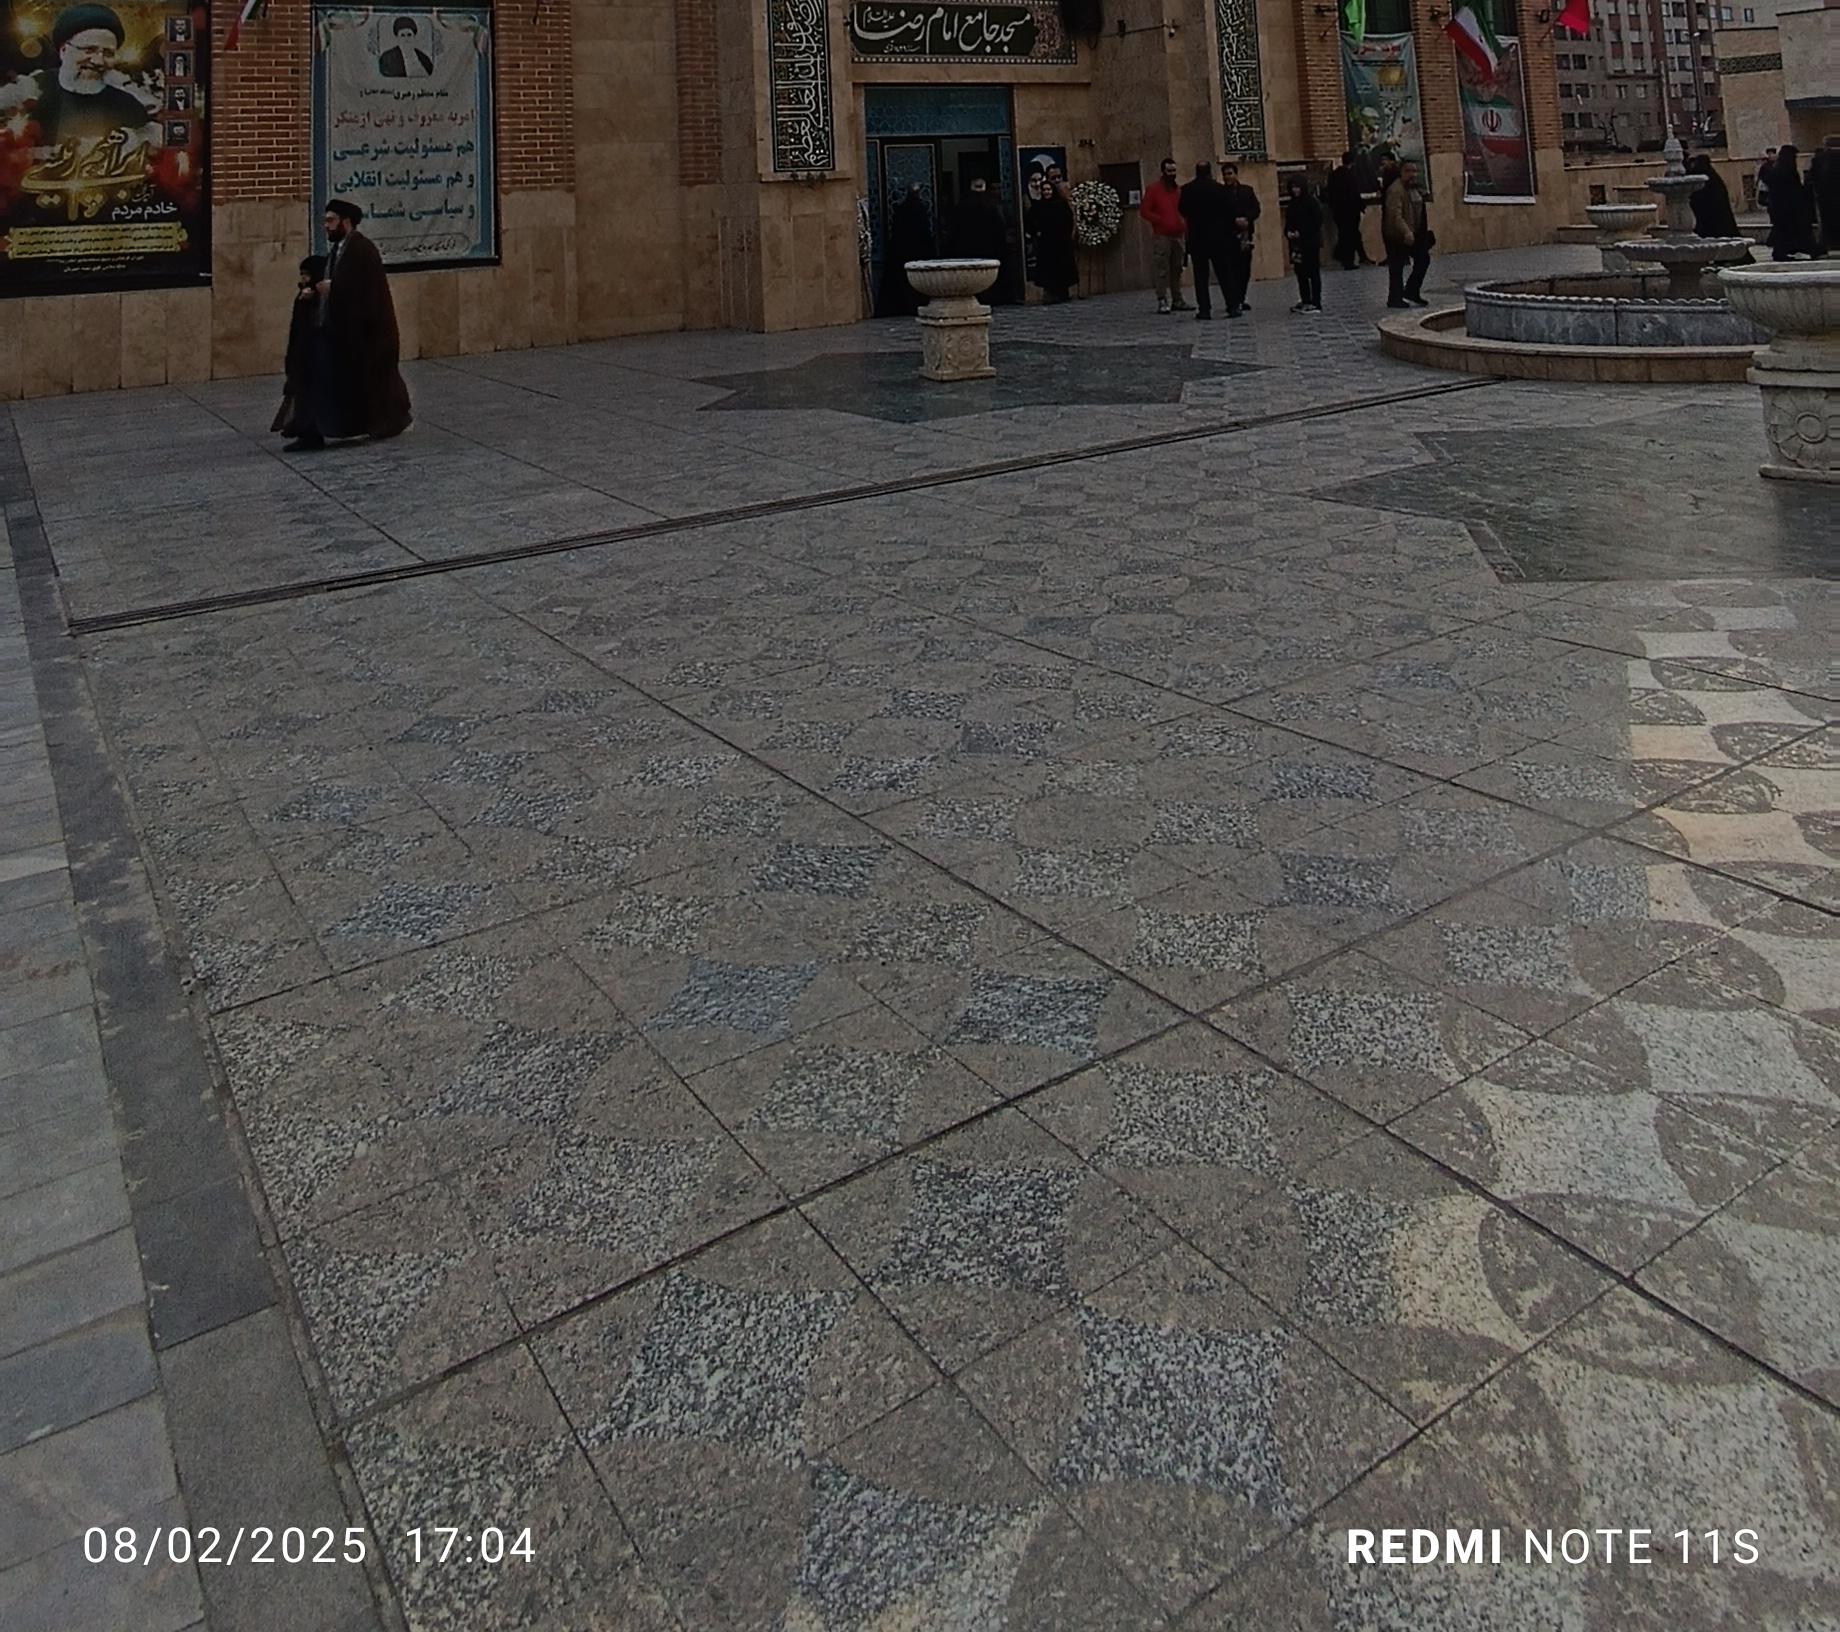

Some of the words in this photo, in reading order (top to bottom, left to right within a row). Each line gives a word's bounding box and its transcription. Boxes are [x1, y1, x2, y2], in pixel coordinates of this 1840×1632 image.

[853, 4, 926, 42] رضا
[925, 6, 958, 55] امام
[958, 9, 999, 54] جامع
[995, 13, 1032, 53] مسجد
[333, 141, 391, 160] شرعی
[457, 140, 474, 157] هم
[335, 170, 382, 193] انقلابی
[446, 171, 463, 189] هم
[467, 173, 474, 189] و
[112, 205, 143, 221] مردم
[144, 202, 177, 220] خادم
[410, 200, 463, 221] سیاسی
[468, 205, 475, 220] و
